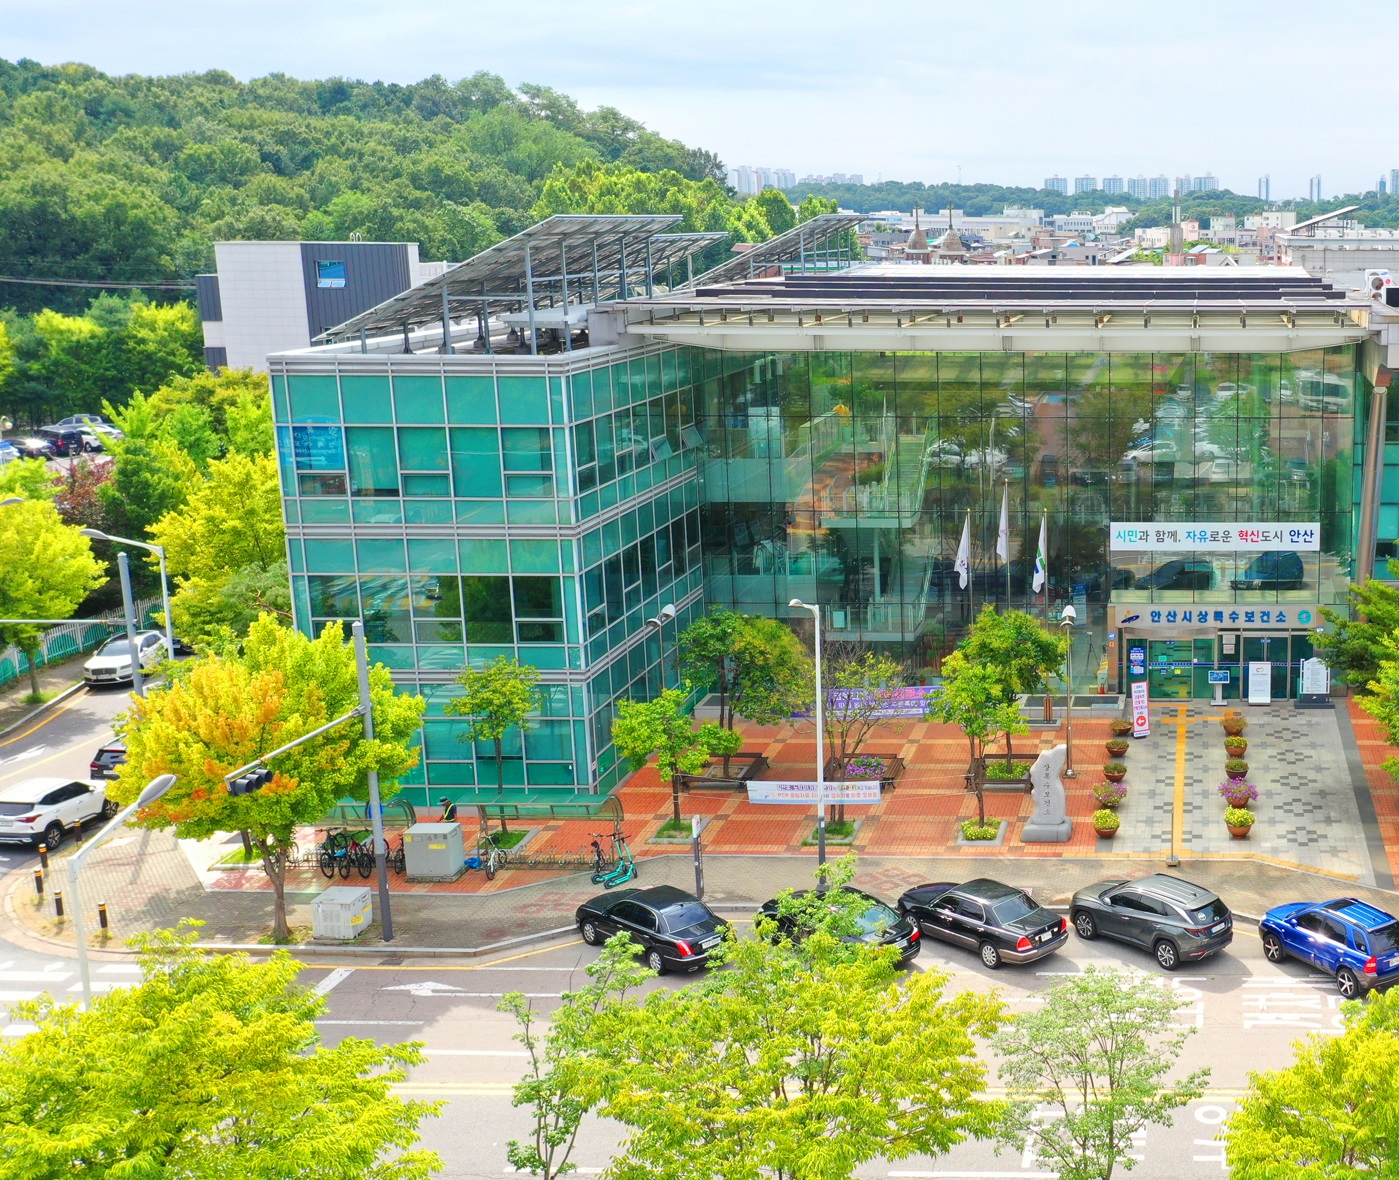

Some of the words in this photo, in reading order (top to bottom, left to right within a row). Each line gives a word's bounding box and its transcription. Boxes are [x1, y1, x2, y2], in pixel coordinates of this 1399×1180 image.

[1116, 530, 1150, 543] 시민과
[1185, 530, 1233, 543] 자유로운
[1238, 530, 1283, 543] 혁신도시
[1289, 530, 1315, 543] 안산
[1043, 763, 1052, 816] 상록수보건소
